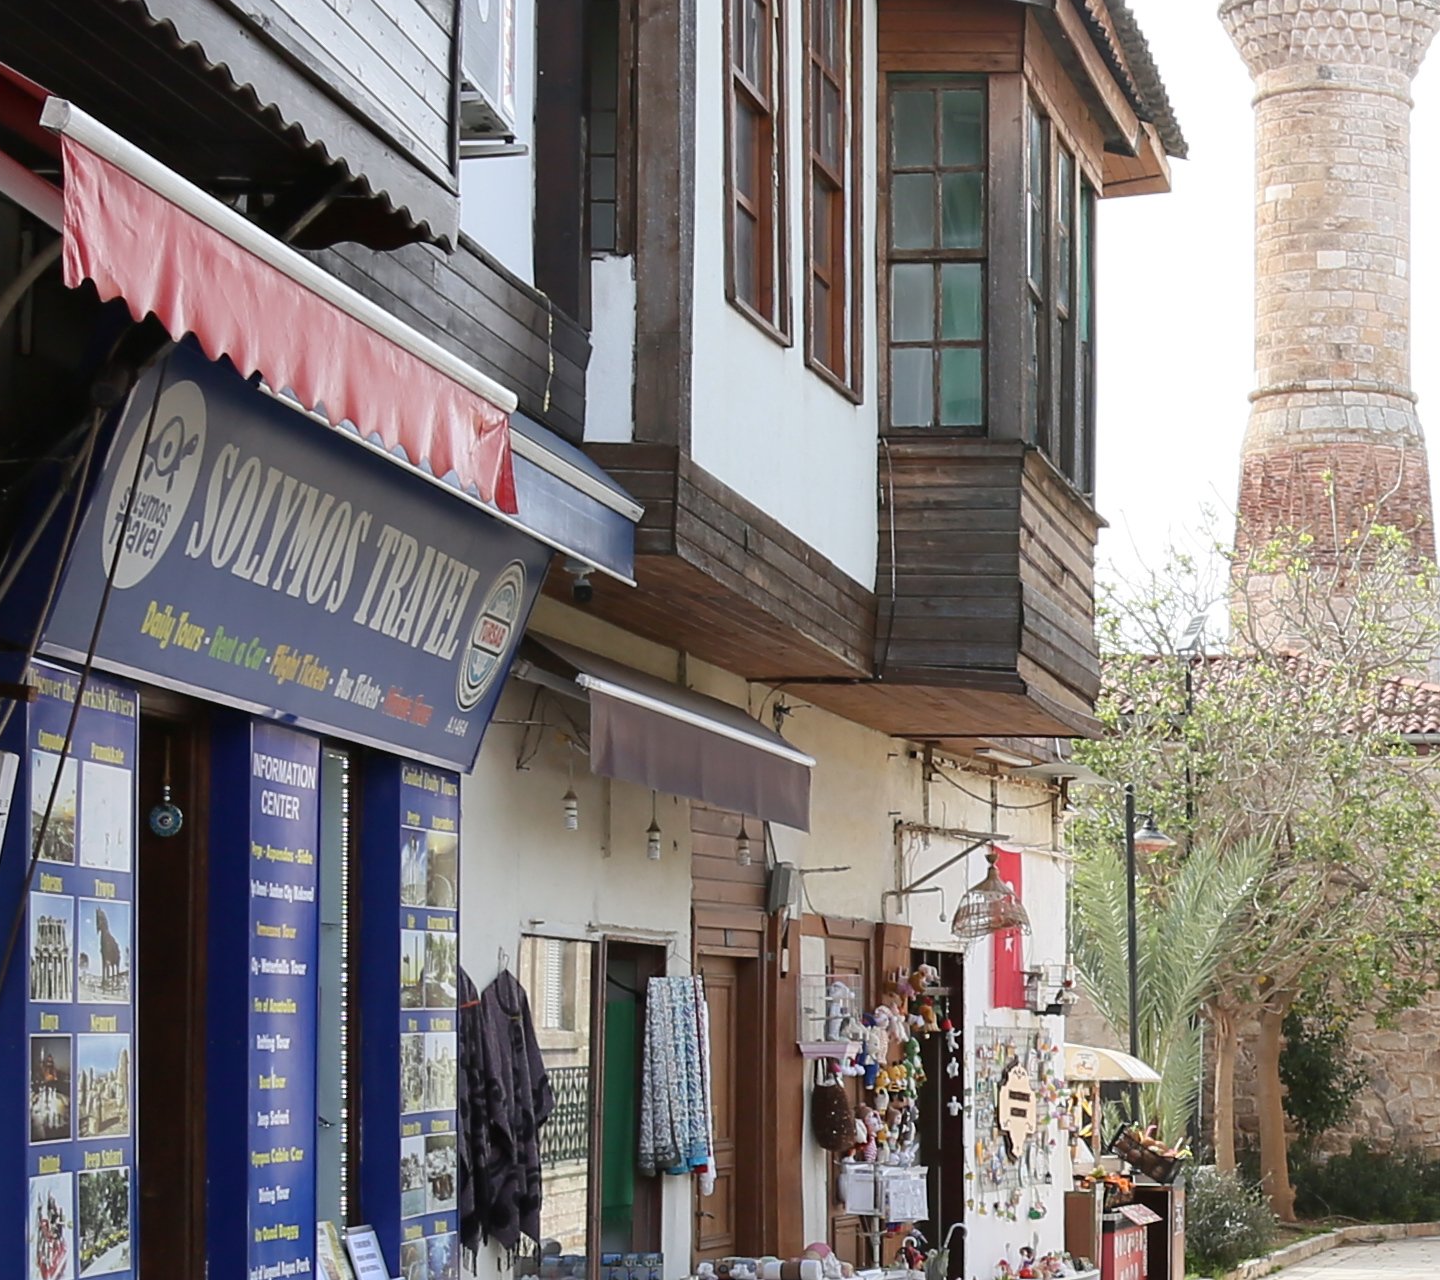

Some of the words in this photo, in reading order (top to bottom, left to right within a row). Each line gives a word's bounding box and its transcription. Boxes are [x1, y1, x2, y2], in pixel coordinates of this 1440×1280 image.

[185, 443, 373, 613] SOLYMOS
[353, 524, 480, 661] TRAVEL
[140, 600, 176, 649] Daily
[173, 610, 206, 652] Tours
[209, 625, 240, 663] Rent
[244, 636, 268, 671] Car
[297, 654, 330, 692] Tickets
[333, 667, 354, 701] Bus
[350, 673, 382, 710] Tickets
[261, 789, 300, 821] CENTER
